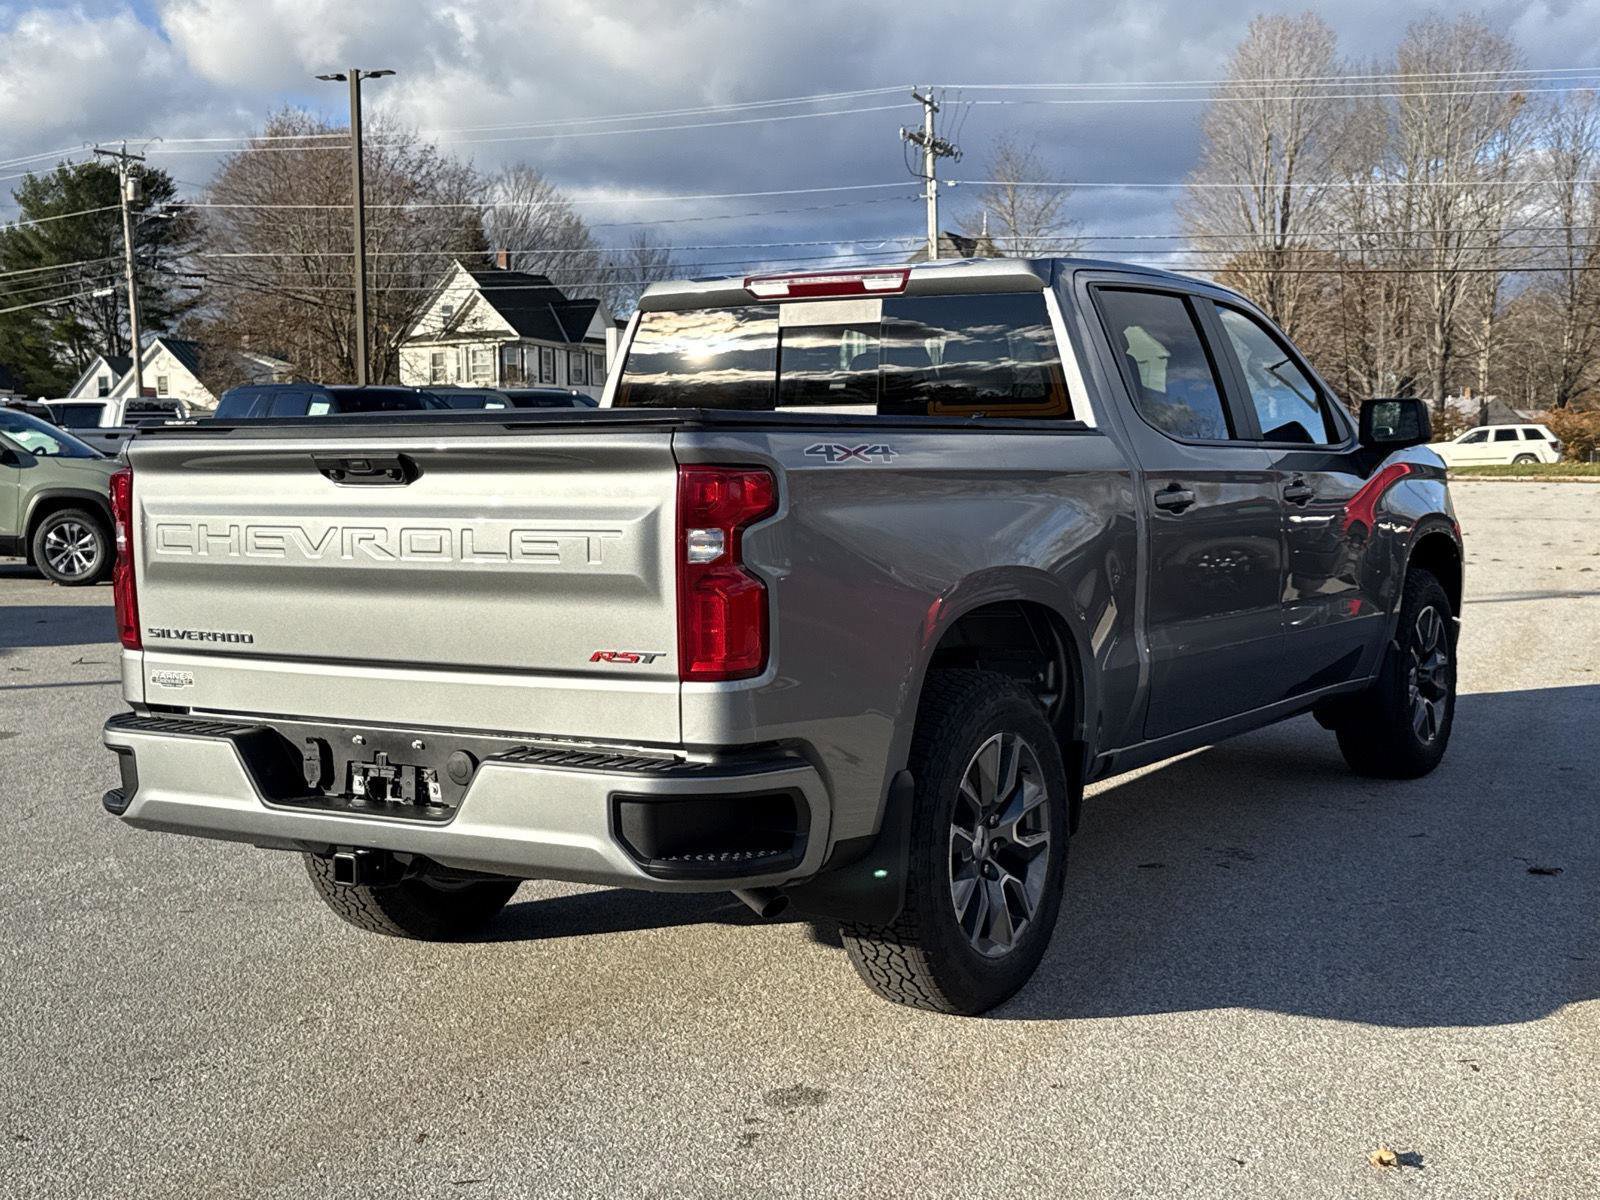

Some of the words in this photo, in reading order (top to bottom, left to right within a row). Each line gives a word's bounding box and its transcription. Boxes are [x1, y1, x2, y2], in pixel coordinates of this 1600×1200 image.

[803, 443, 899, 464] 4X4
[154, 521, 624, 566] CHEVROLET
[148, 628, 254, 644] SILVERADO
[589, 649, 667, 665] RST
